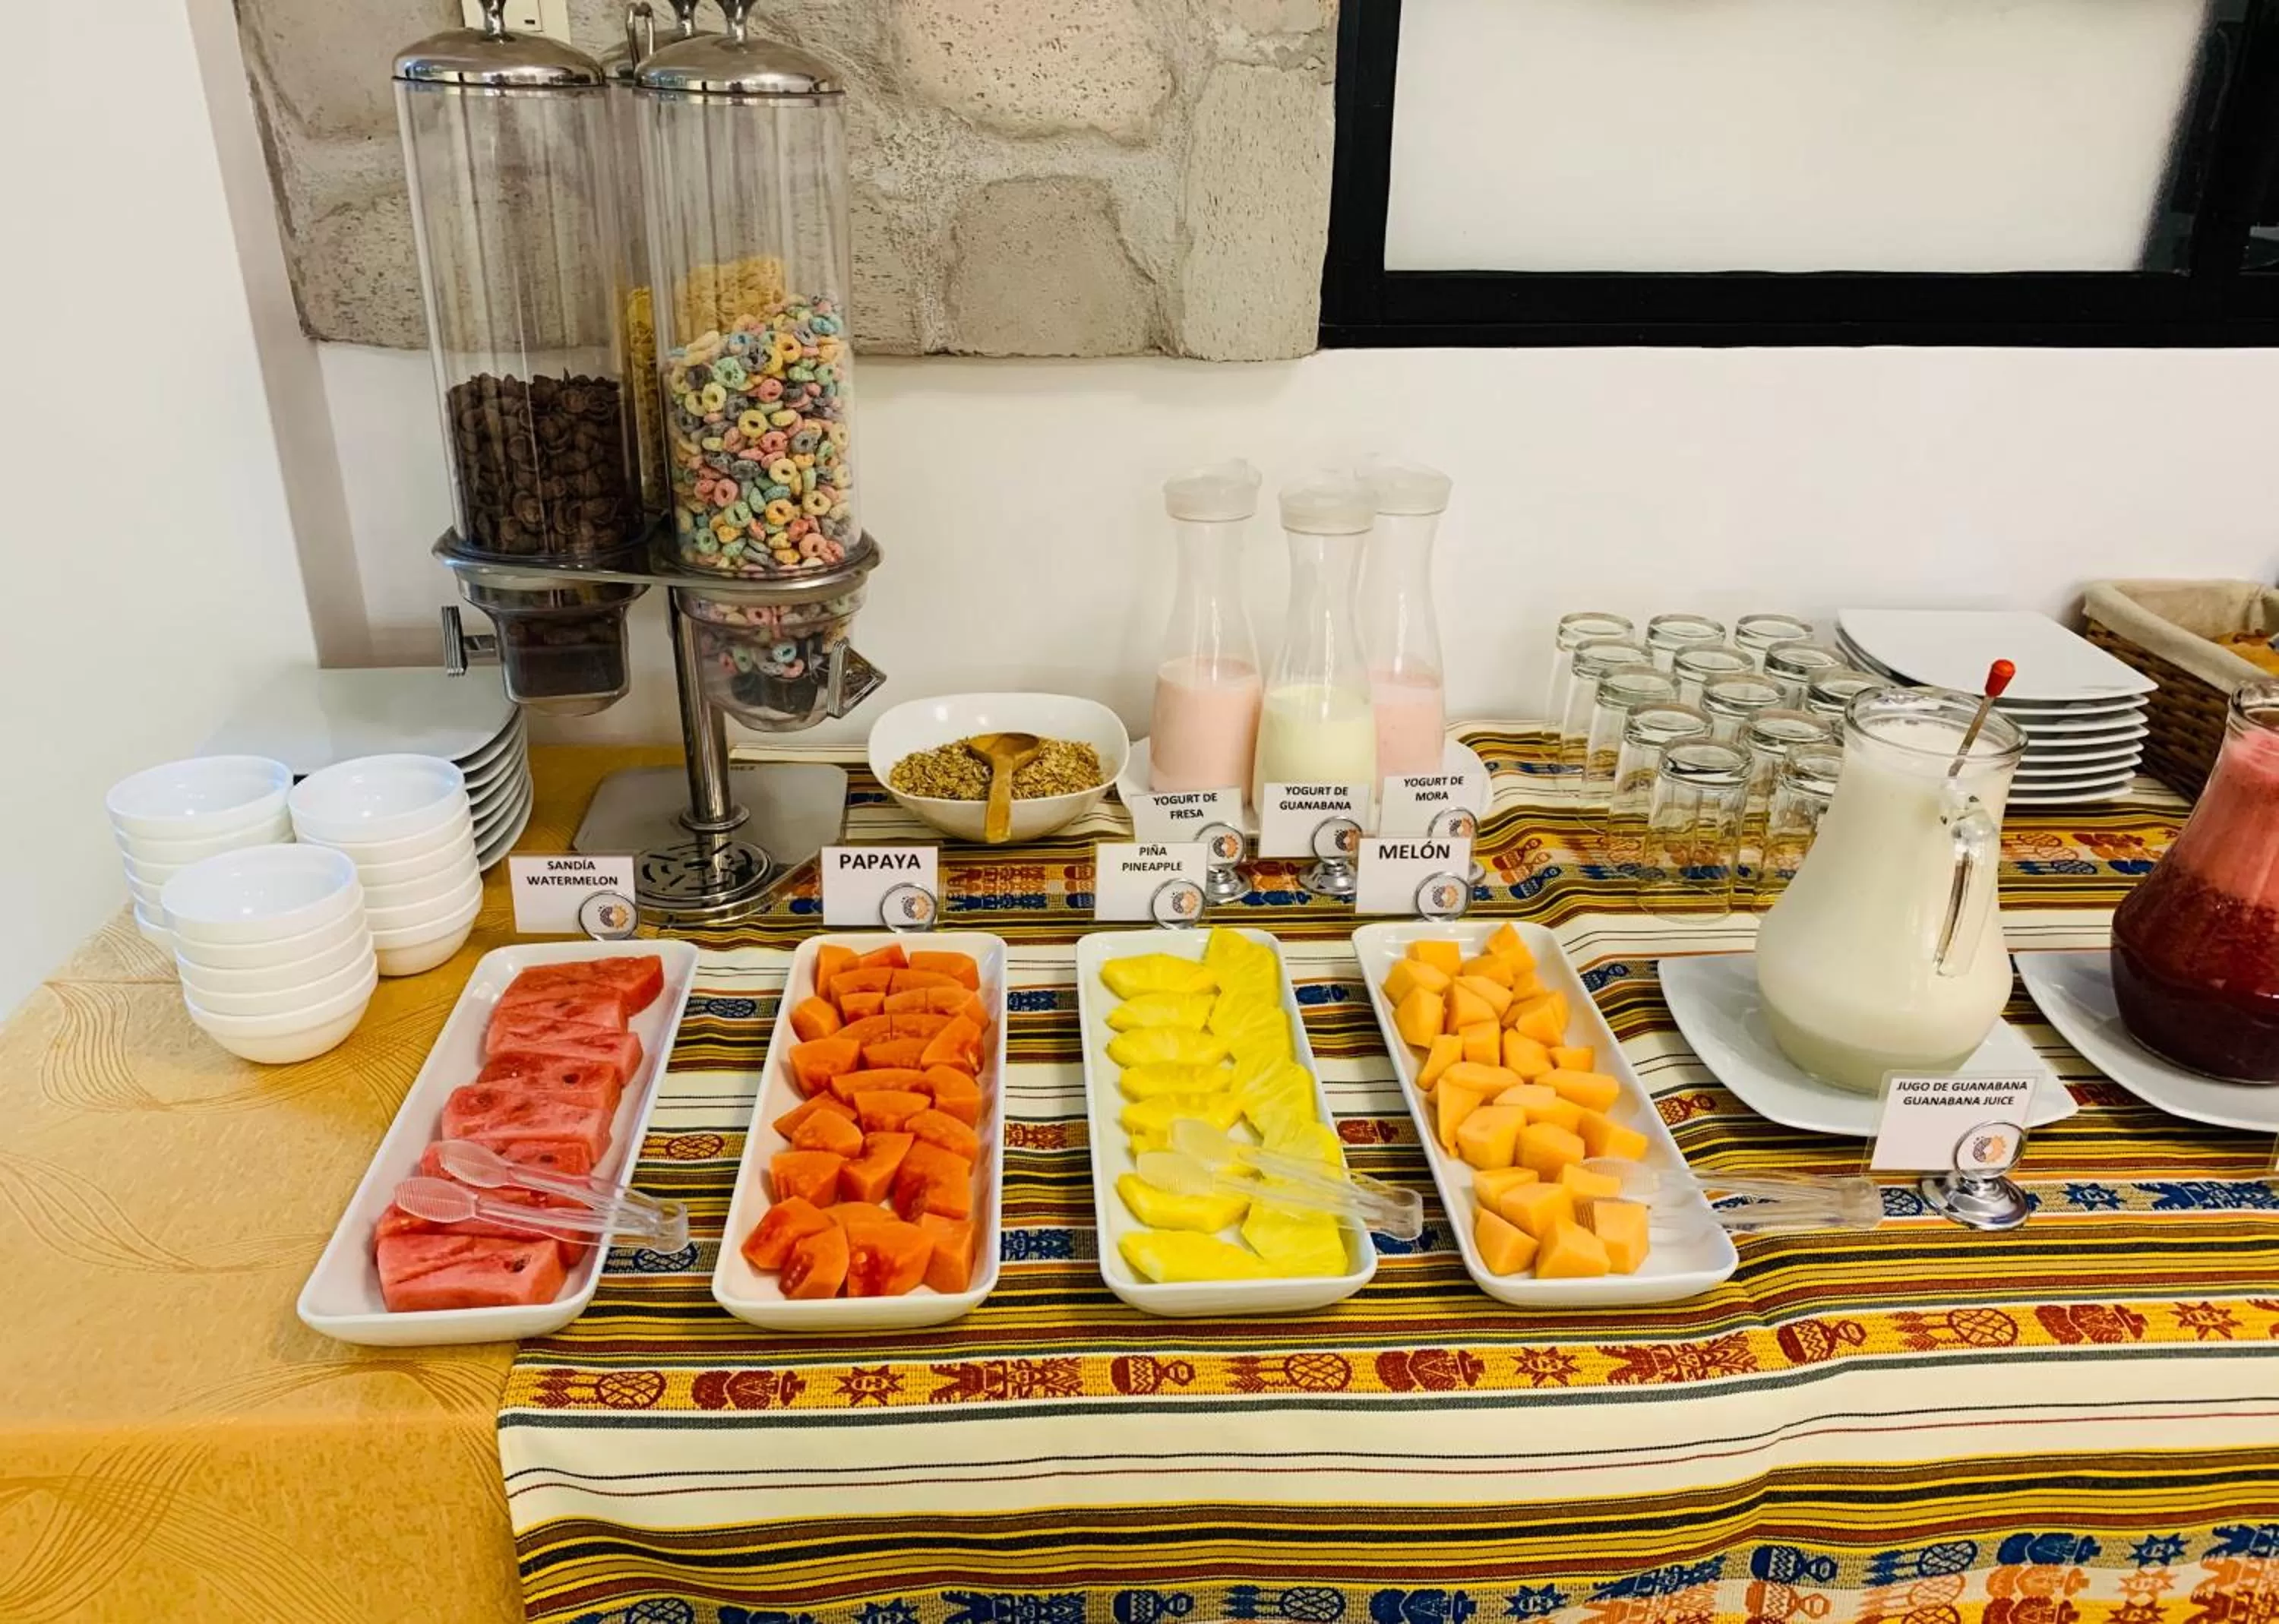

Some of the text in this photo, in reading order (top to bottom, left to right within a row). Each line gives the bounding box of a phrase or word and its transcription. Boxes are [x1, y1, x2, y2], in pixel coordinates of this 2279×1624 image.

[1404, 776, 1464, 787] YOGURT DE
[1285, 786, 1348, 796] YOGURT DE
[1415, 791, 1449, 801] MORA
[1153, 792, 1218, 805] YOGURT DE
[1279, 801, 1351, 810] GUANABANA
[1170, 809, 1204, 820] FRESA
[1140, 845, 1168, 856] PIÑA
[1379, 841, 1450, 859] MELÓN
[547, 858, 596, 870] SANDÍA
[839, 854, 921, 869] PAPAYA
[1122, 861, 1183, 872] PINEAPPLE
[526, 876, 618, 886] WATERMELON
[1897, 1081, 2028, 1092] JUGO DE GUANABANA
[1903, 1096, 2015, 1105] GUANABANA JUICE
